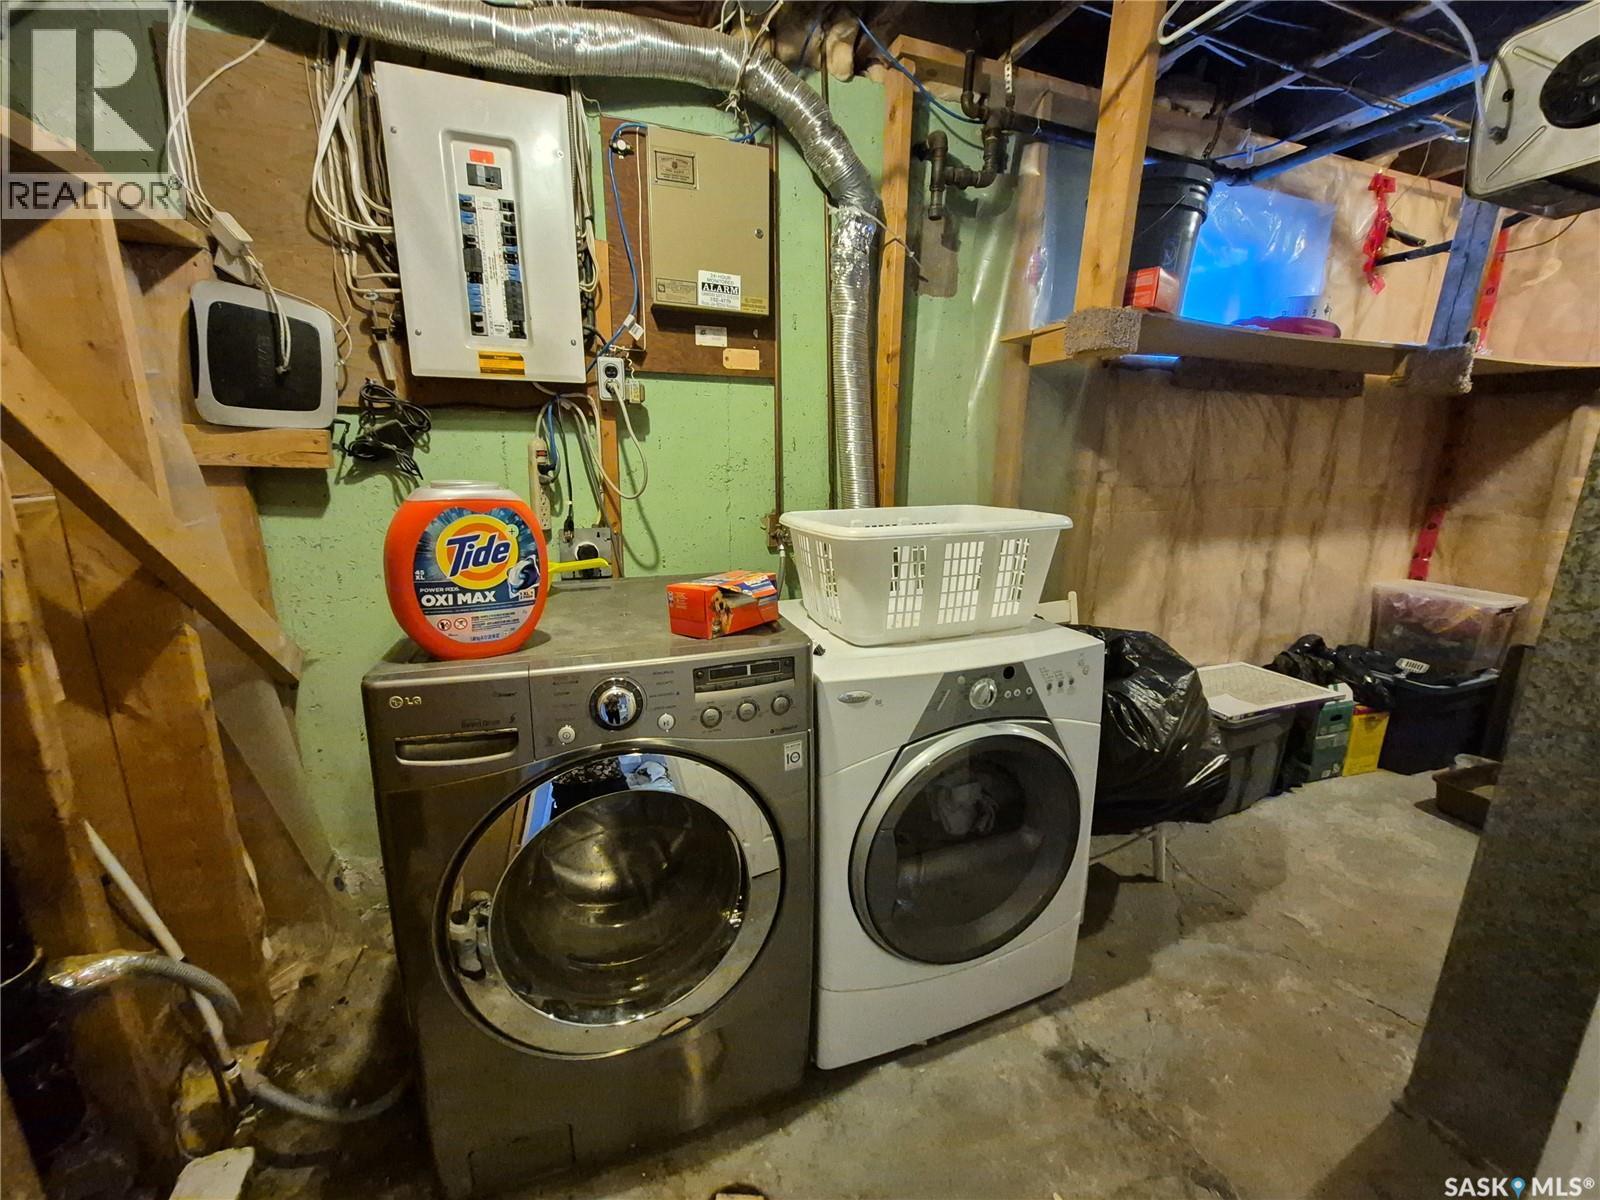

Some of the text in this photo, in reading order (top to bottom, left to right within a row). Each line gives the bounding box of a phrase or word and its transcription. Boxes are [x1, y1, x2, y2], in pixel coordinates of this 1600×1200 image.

[702, 283, 739, 296] ALARM
[446, 532, 511, 578] Tide
[421, 591, 497, 607] OXI MAX
